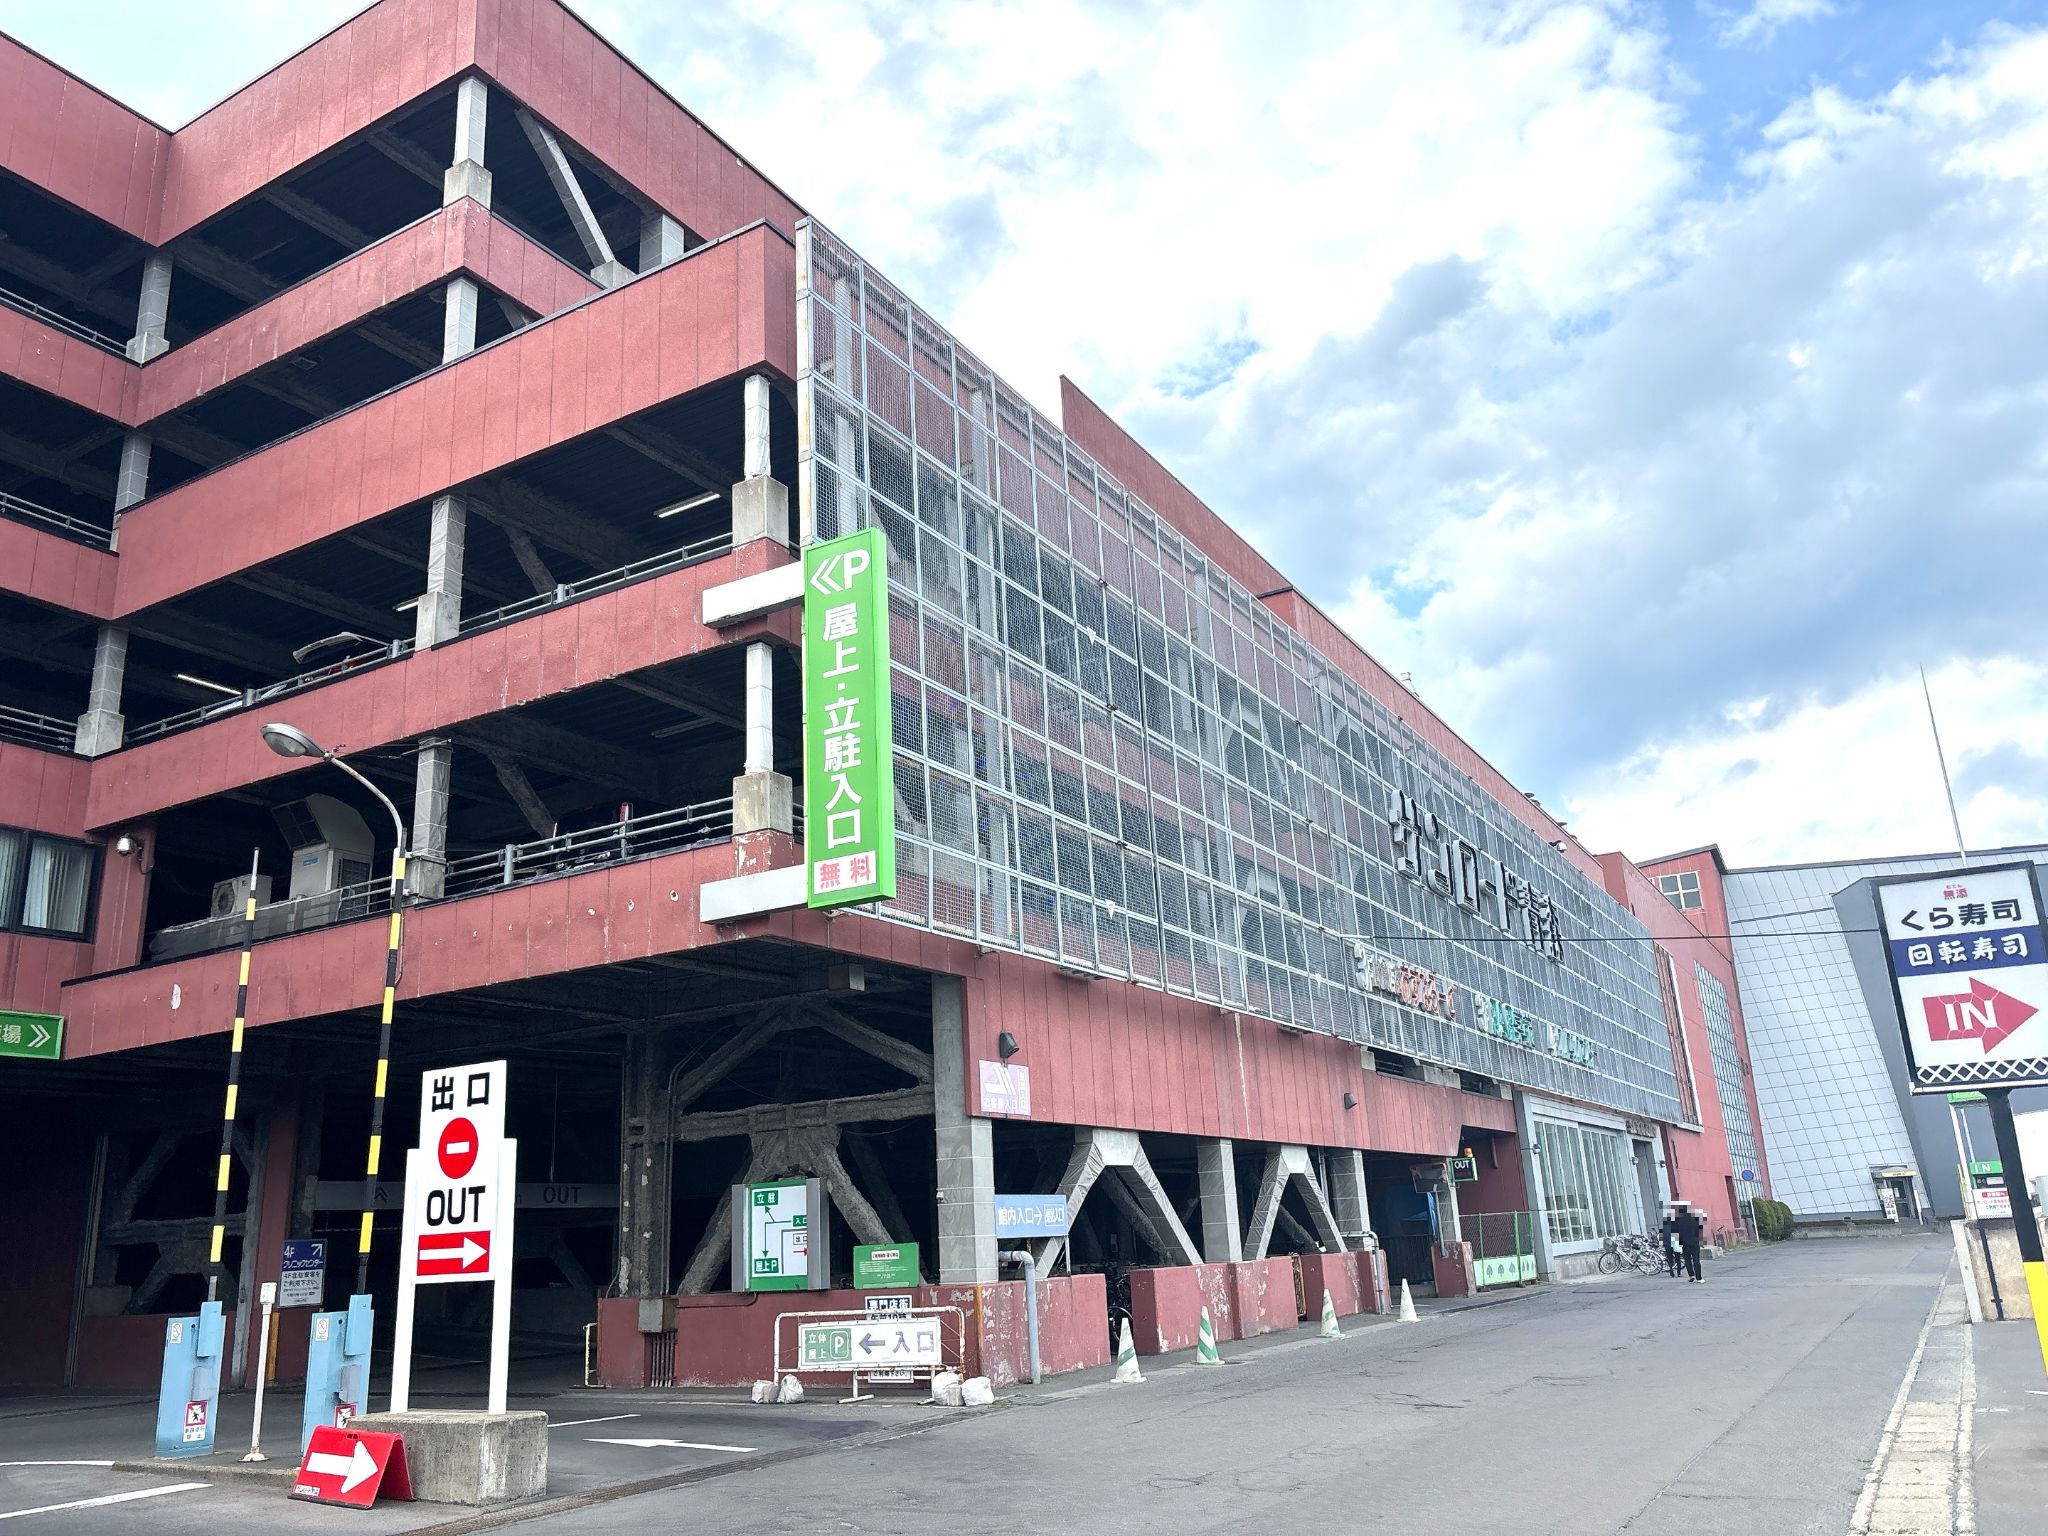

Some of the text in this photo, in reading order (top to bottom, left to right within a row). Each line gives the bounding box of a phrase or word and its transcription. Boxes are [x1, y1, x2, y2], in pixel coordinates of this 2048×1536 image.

[844, 549, 870, 589] P
[819, 856, 872, 889] 無料
[1944, 888, 1968, 900] 無添
[1901, 899, 2022, 931] くら寿司
[1907, 933, 2028, 967] 回転寿司
[1944, 1000, 1998, 1031] IN
[0, 1024, 21, 1043] 場
[432, 1072, 490, 1112] 出口
[1454, 1161, 1470, 1170] OUT
[1974, 1163, 1991, 1173] IN
[543, 1186, 583, 1204] OUT
[427, 1185, 486, 1227] OUT
[284, 1245, 295, 1258] 4F
[283, 1259, 323, 1268] クリニックセンター
[808, 1332, 826, 1344] 立体
[834, 1336, 844, 1354] P
[892, 1331, 934, 1353] 入口
[808, 1349, 827, 1360] 屋上
